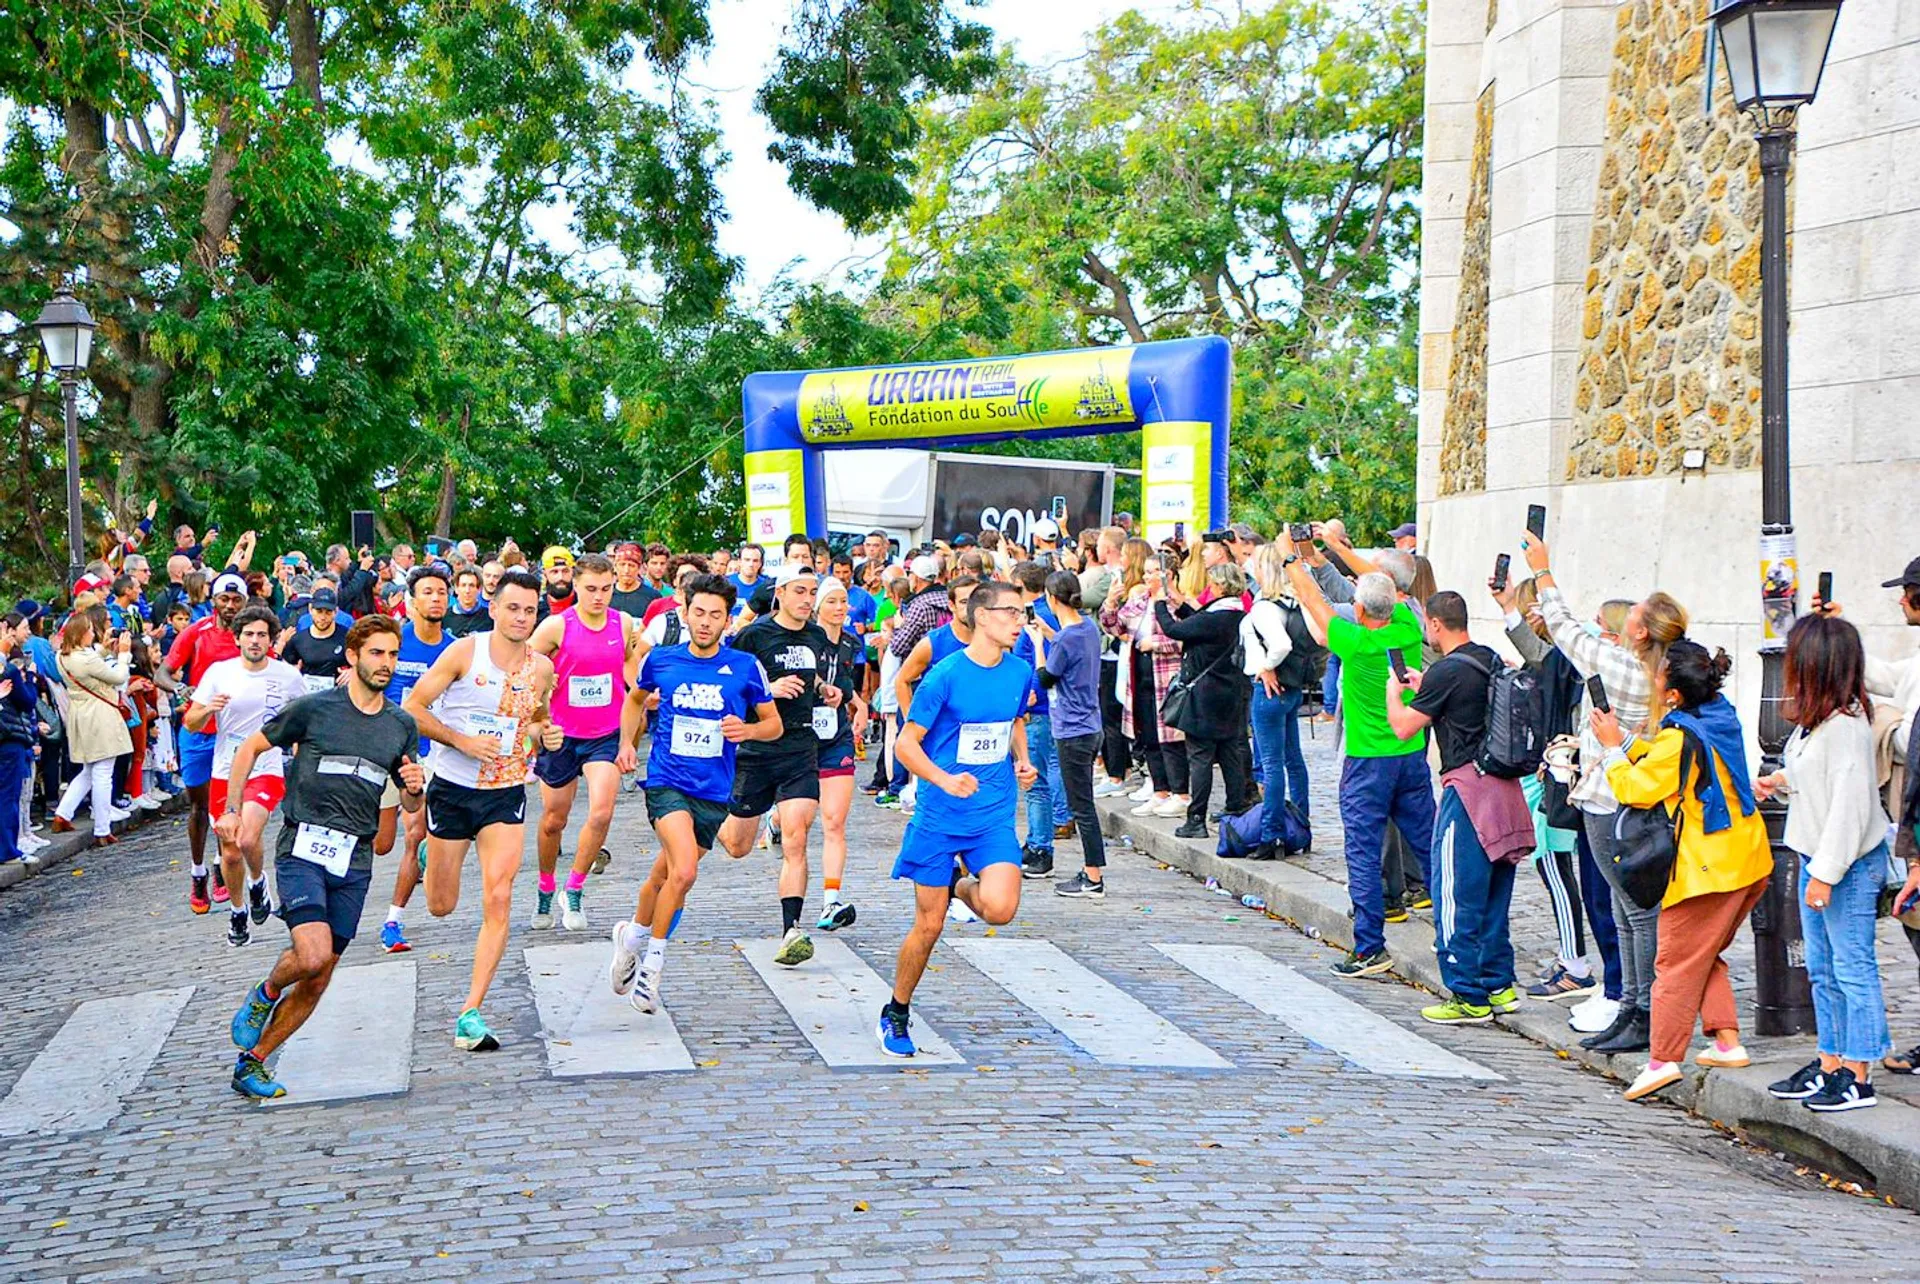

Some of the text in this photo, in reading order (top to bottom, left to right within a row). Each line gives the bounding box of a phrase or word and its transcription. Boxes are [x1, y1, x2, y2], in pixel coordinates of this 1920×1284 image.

[868, 363, 1016, 406] URBAN TRAIL
[869, 406, 952, 427] Fondation
[959, 403, 980, 420] du
[786, 646, 803, 654] THE
[775, 653, 804, 663] NORTH
[784, 661, 805, 670] FACE
[580, 687, 602, 697] 664
[690, 683, 723, 699] 10K
[672, 693, 725, 711] PARIS
[684, 732, 711, 744] 974
[973, 739, 997, 751] 281
[310, 842, 337, 859] 525
